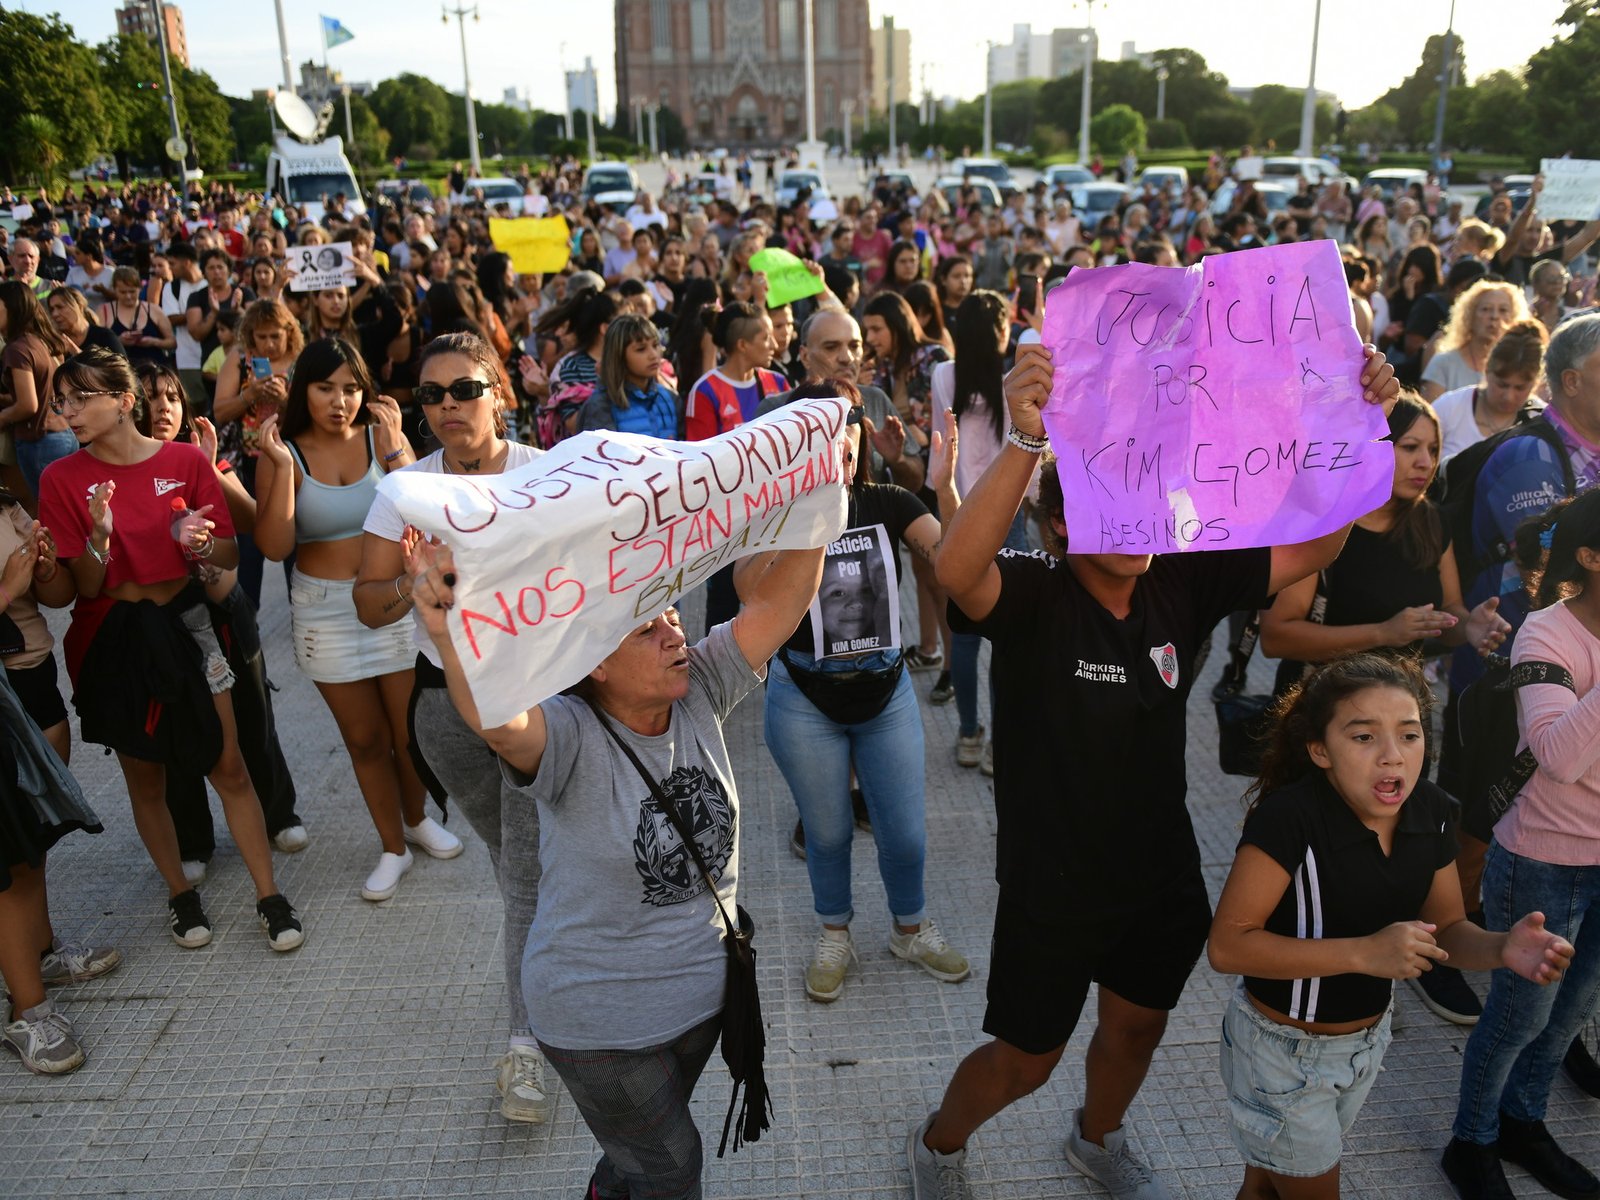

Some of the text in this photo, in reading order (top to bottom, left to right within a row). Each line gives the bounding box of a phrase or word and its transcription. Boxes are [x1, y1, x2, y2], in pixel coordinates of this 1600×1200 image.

[1154, 364, 1218, 411] POR
[606, 399, 843, 542] SEGURIDAD
[1194, 440, 1363, 507] GOMEZ
[634, 497, 796, 618] BASTA!!
[826, 534, 873, 556] usticia
[461, 566, 586, 660] NOS
[608, 498, 731, 594] ESTAN
[838, 560, 862, 578] Por
[1311, 593, 1328, 624] NIKE
[832, 636, 880, 653] KIM GOMEZ
[1239, 626, 1257, 657] NIKE
[1074, 668, 1127, 684] AIRLINES
[1077, 659, 1125, 675] TURKISH
